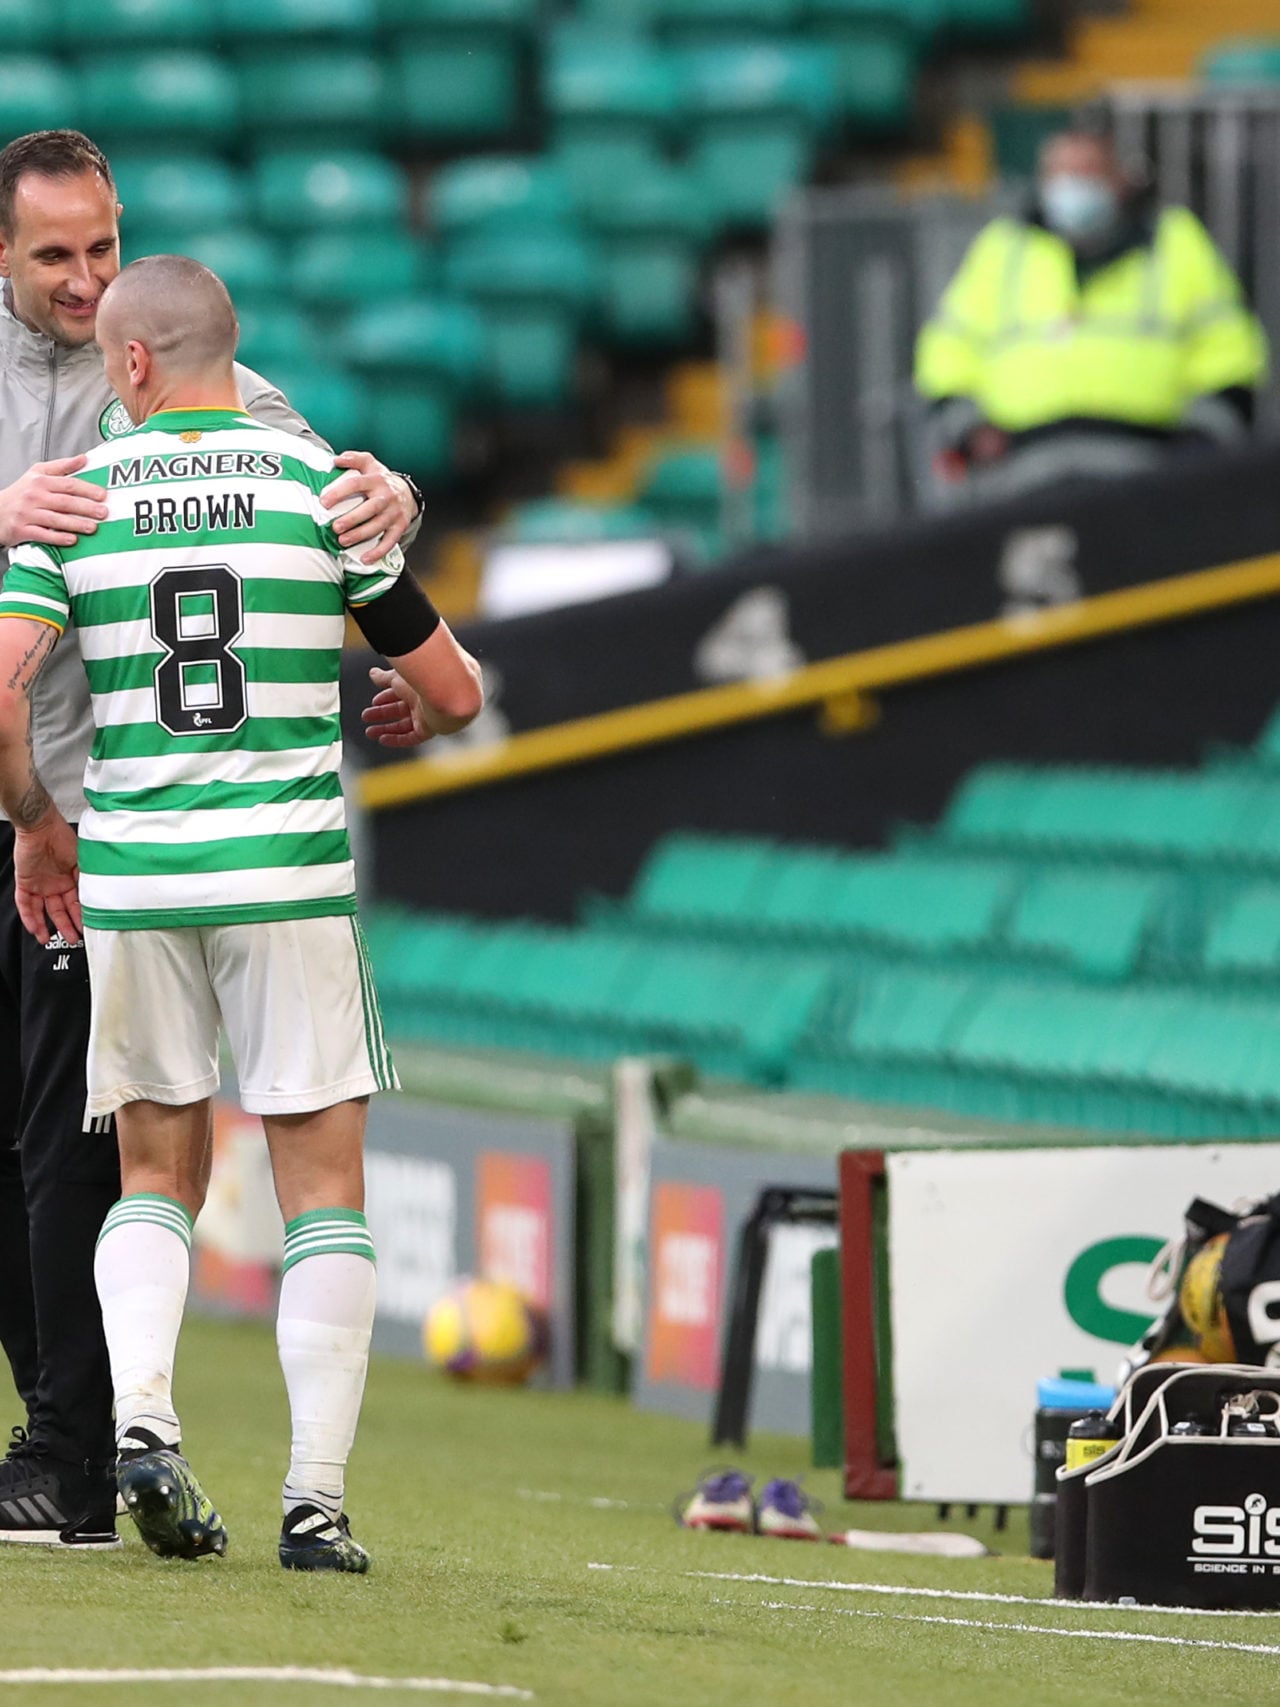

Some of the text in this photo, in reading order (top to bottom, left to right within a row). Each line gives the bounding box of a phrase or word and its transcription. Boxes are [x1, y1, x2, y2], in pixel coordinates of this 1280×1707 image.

[109, 453, 282, 487] MAGNERS
[134, 493, 256, 535] BROWN
[149, 563, 249, 736] 8
[52, 954, 70, 970] JK
[1193, 1563, 1248, 1573] SCIENCE
[1252, 1564, 1265, 1574] IN
